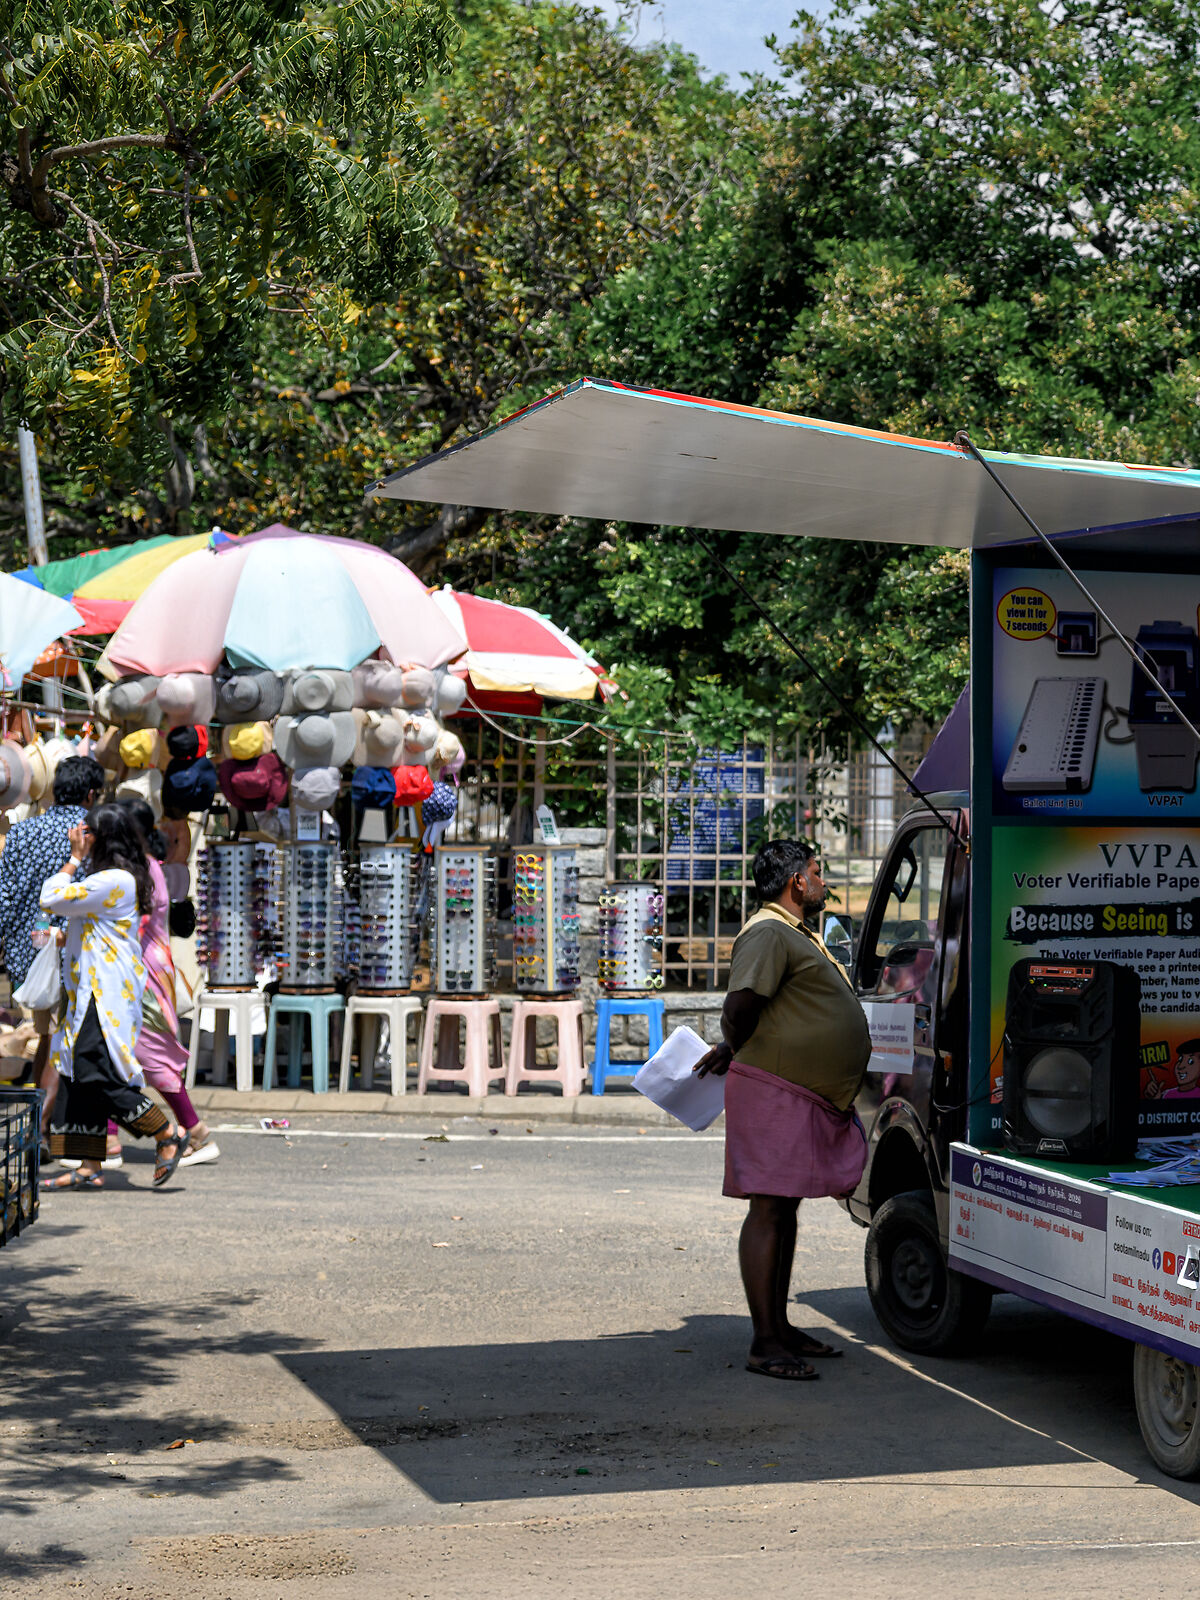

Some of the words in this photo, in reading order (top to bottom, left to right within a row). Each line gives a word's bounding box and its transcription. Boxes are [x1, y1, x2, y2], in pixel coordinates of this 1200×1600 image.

[1147, 796, 1184, 807] VVPAT
[1013, 873, 1062, 888] Voter
[1067, 873, 1151, 888] Verifiable
[1011, 906, 1094, 932] Because
[1102, 905, 1168, 936] Seeing
[1176, 907, 1193, 930] is
[1094, 949, 1143, 959] Verifiable
[1146, 949, 1176, 961] Paper
[1138, 964, 1156, 972] see
[1171, 976, 1200, 986] Name
[1161, 991, 1178, 1002] you
[1147, 1112, 1188, 1124] DISTRICT
[1115, 1215, 1134, 1232] Follow
[1134, 1223, 1142, 1234] us
[1142, 1226, 1152, 1238] on:
[1113, 1242, 1150, 1262] ceotamilnadu
[1113, 1273, 1135, 1289] மாவட்ட
[1137, 1279, 1161, 1298] தேர்தல்
[1163, 1289, 1193, 1308] அலுவலர்
[1112, 1294, 1134, 1311] மாவட்ட
